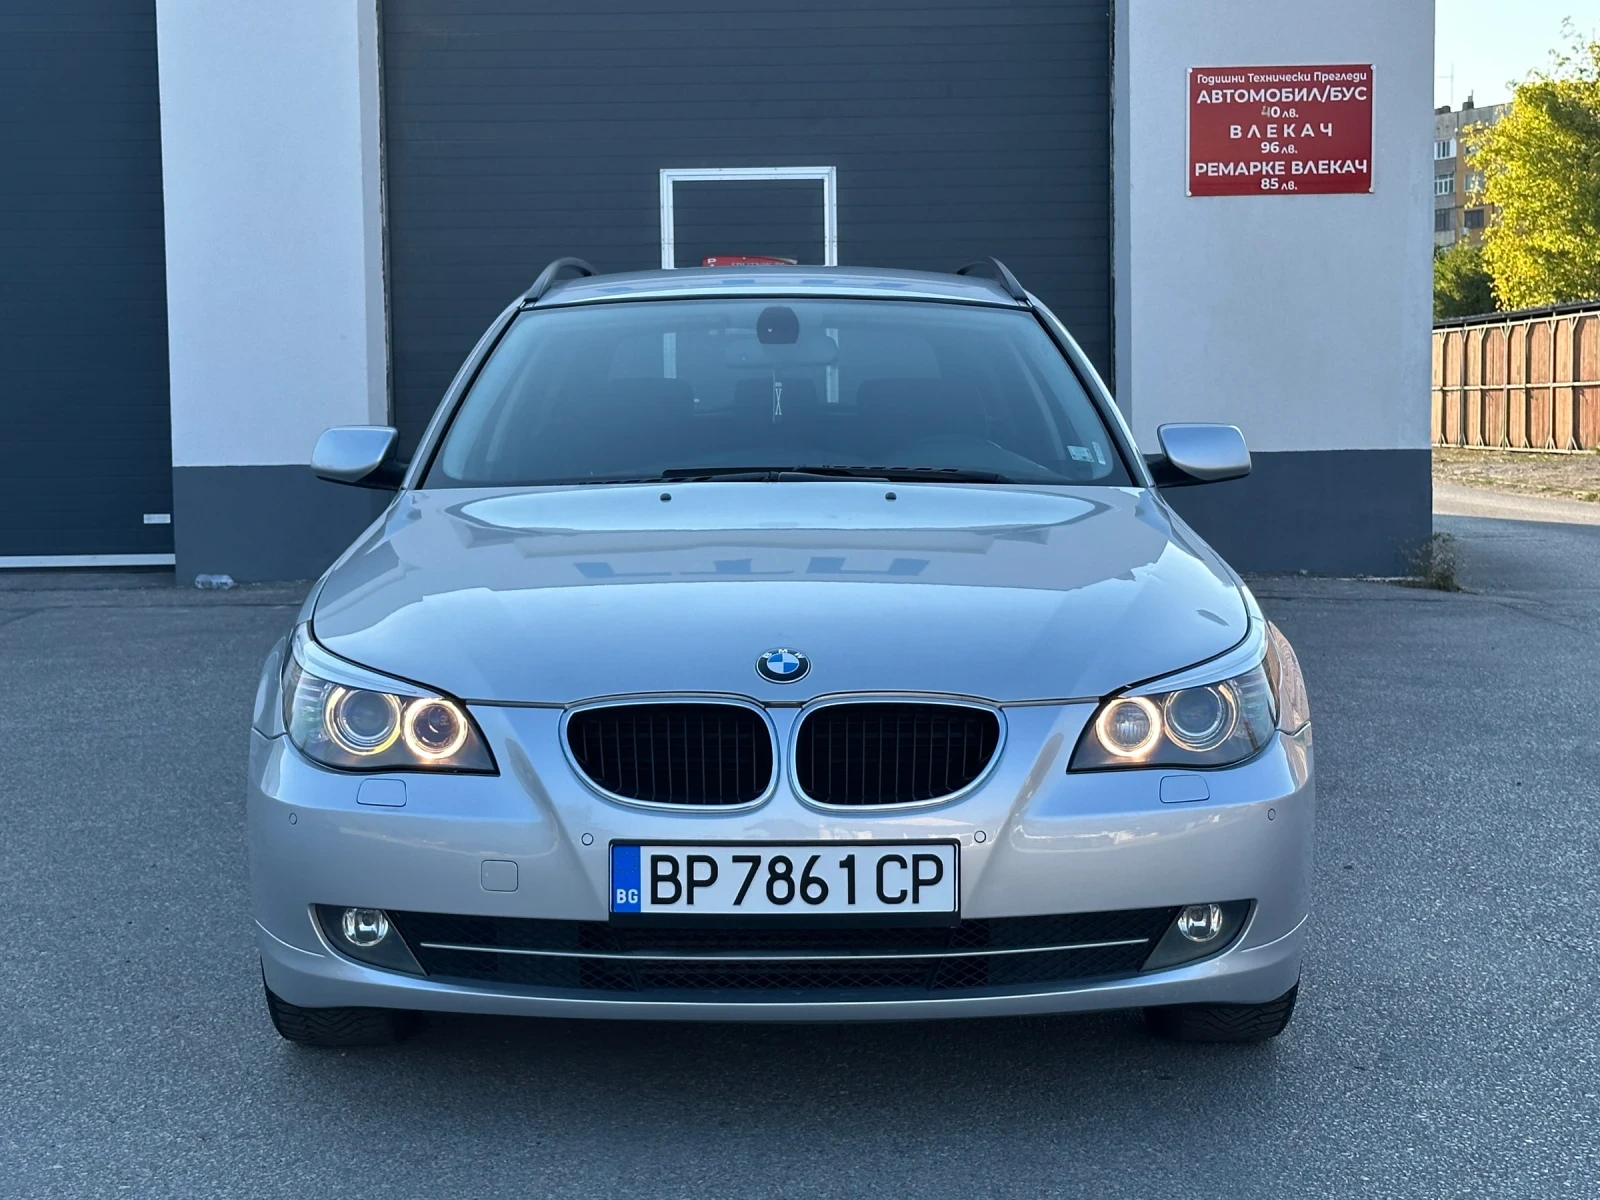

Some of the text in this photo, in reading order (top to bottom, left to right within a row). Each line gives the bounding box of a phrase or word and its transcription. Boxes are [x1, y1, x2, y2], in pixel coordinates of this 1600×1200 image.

[1197, 71, 1367, 86] Годишни Технически Прегледи
[1196, 85, 1367, 104] АВТОМОБИЛ/БУС
[1261, 105, 1299, 118] 40 лв.
[1229, 123, 1333, 139] ВЛЕКАЧ
[1260, 141, 1298, 155] 96 лв.
[1195, 159, 1367, 177] РЕМАРКЕ ВЛЕКАЧ
[1260, 178, 1298, 191] 85 лв.
[762, 648, 806, 659] BMW
[650, 853, 944, 905] BP 7861 CP
[616, 889, 639, 904] BG
